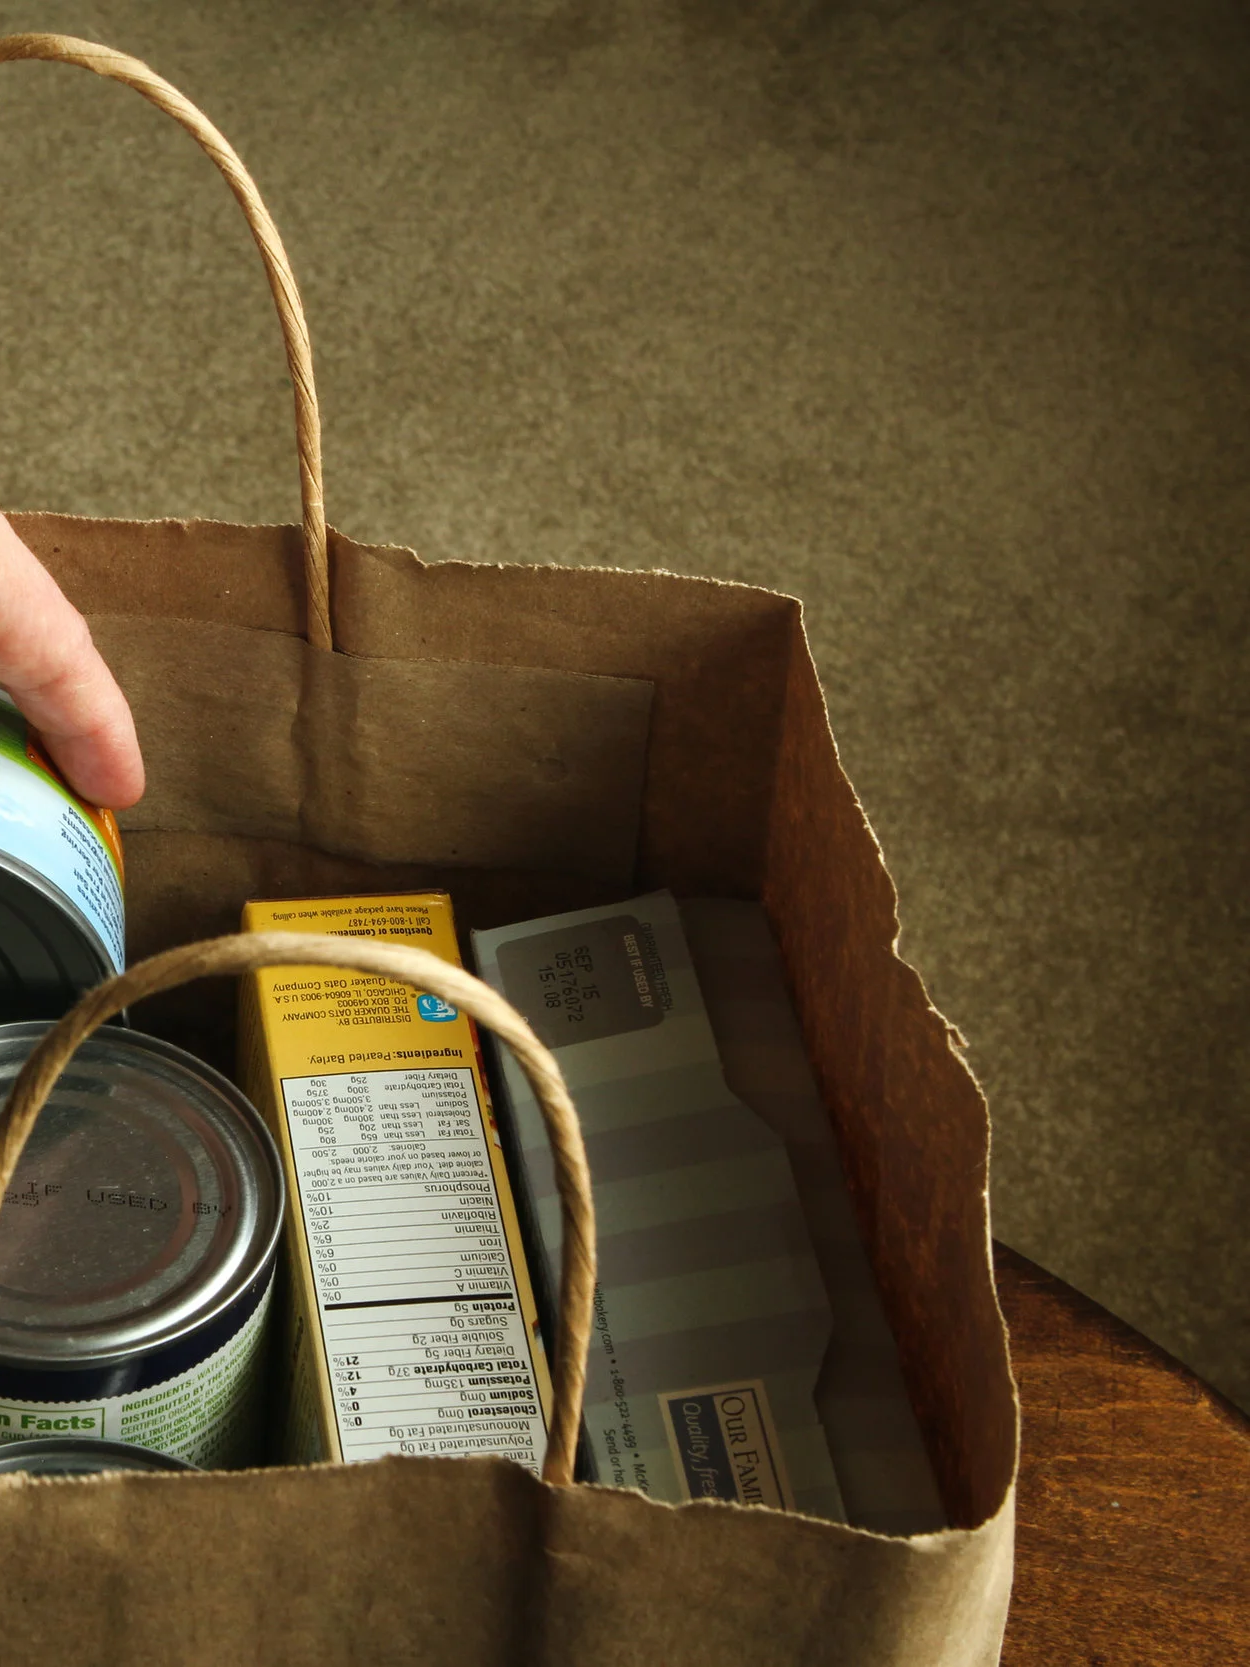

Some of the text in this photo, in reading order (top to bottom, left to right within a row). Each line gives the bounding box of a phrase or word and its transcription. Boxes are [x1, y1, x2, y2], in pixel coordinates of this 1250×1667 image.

[60, 828, 91, 868] Serving
[297, 910, 319, 920] when
[319, 908, 353, 918] available
[354, 904, 385, 916] package
[385, 906, 405, 915] have
[405, 906, 429, 915] Please
[348, 916, 431, 928] Call 1-800-694-7487
[378, 927, 388, 935] or
[389, 924, 433, 937] Questions
[574, 947, 593, 972] SEP
[641, 923, 673, 1011] GUARANTEED FRESH
[623, 934, 653, 1008] BEST IF USED BY
[272, 975, 387, 992] Quaker Oats Company
[538, 966, 561, 1009] 15:08
[272, 987, 407, 1004] CHICAGO, IL 60604-9003 U.S.A.
[336, 996, 408, 1009] P.O. BOX 049003
[282, 1005, 411, 1022] THE QUAKER OATS COMPANY
[335, 1014, 412, 1026] DISTRIBUTED BY:
[307, 1047, 463, 1065] Ingredients: Pearled Barley.
[27, 1182, 62, 1196] IF
[87, 1189, 167, 1212] USED
[192, 1202, 233, 1217] BY
[306, 1182, 491, 1203] Phosphorus 10%
[308, 1196, 494, 1217] Niacin 10%
[310, 1210, 497, 1231] Riboflavin 2%
[313, 1224, 501, 1245] Thiamin 6%
[315, 1237, 503, 1259] Iron 6%
[317, 1251, 506, 1273] Calcium 0%
[319, 1266, 510, 1288] Vitamin C 0%
[322, 1280, 512, 1302] Vitamin A 0%
[453, 1301, 516, 1314] Protein 5g
[449, 1315, 508, 1329] Sugars 0g
[412, 1331, 505, 1346] Soluble Fiber 2g
[333, 1345, 515, 1367] Dietary Fiber 5g 21%
[335, 1360, 529, 1382] Total Carbohydrate 37g 12%
[122, 1380, 194, 1412] INGREDIENTS:
[337, 1374, 531, 1397] Potassium 135mg 4%
[122, 1372, 221, 1425] DISTRIBUTED BY THE
[340, 1389, 535, 1412] Sodium 0mg 0%
[610, 1369, 637, 1448] 1-800-522-4499
[21, 1415, 96, 1431] Facts
[121, 1415, 166, 1435] CERTIFIED
[168, 1395, 203, 1419] ORGANIC
[149, 1406, 202, 1436] TRUTH ORGANIC
[343, 1404, 538, 1427] Cholesterol 0mg 0%
[389, 1420, 531, 1439] Monounsaturated Fat 0g
[682, 1402, 710, 1462] Quality,
[399, 1435, 534, 1454] Polyunsaturated Fat 0g
[603, 1429, 622, 1454] Send
[609, 1457, 621, 1467] or
